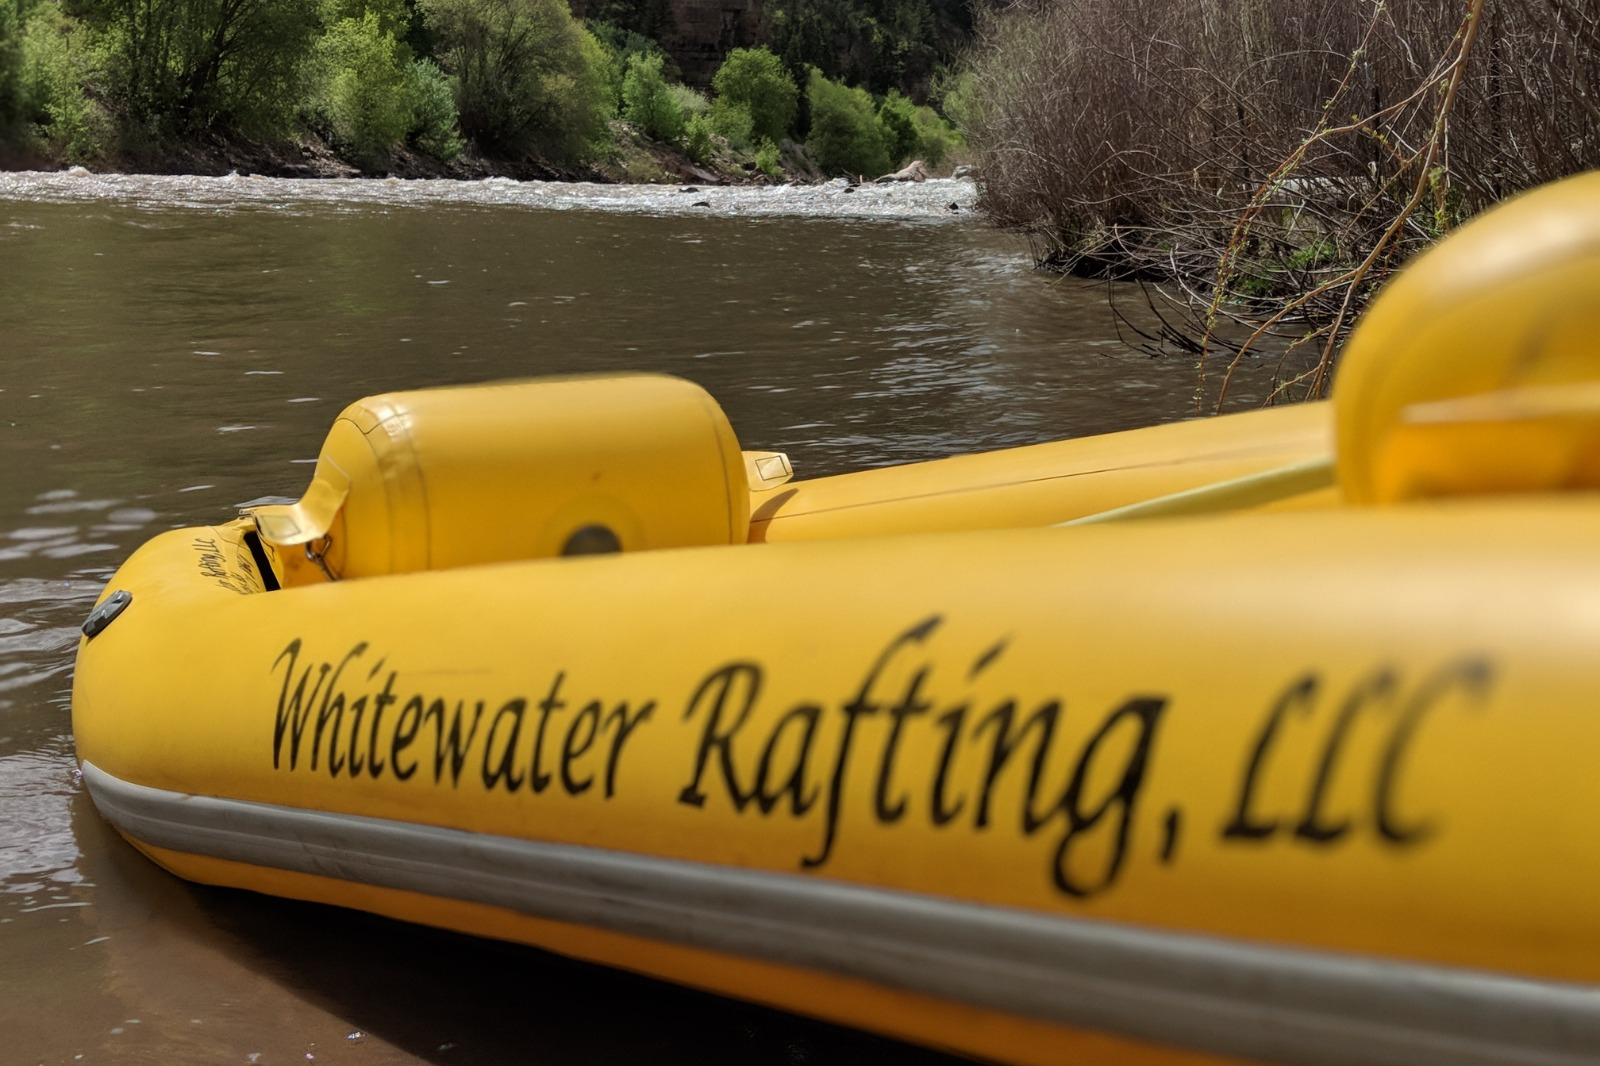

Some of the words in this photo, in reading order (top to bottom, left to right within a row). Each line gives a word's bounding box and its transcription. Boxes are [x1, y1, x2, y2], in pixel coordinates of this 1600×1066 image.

[270, 637, 657, 800] Whitewater
[677, 614, 1182, 899] Rafting,
[1216, 651, 1503, 853] LLC
